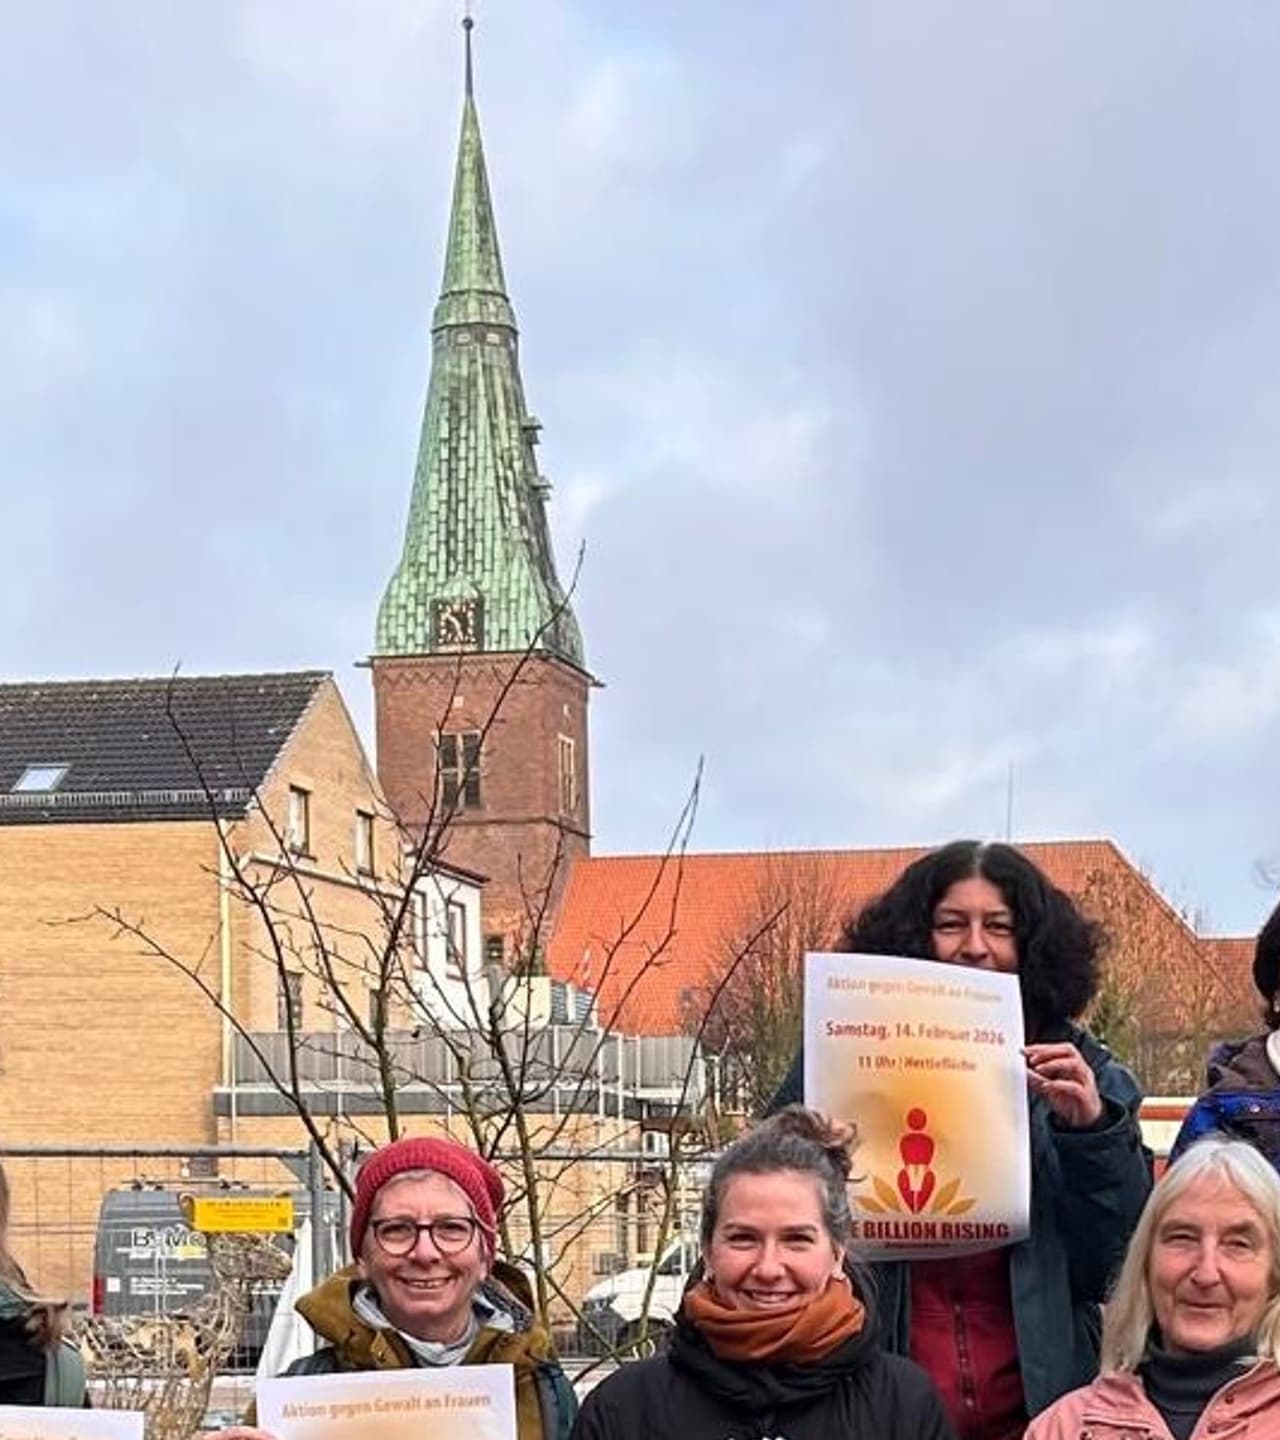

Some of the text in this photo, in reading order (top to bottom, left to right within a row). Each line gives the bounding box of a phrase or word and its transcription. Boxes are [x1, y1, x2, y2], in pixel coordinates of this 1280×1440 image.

[896, 1023, 914, 1037] 14.
[919, 1024, 970, 1042] Februar
[973, 1029, 1005, 1044] 2026
[863, 1221, 937, 1240] BILLION
[942, 1222, 1009, 1240] RISING
